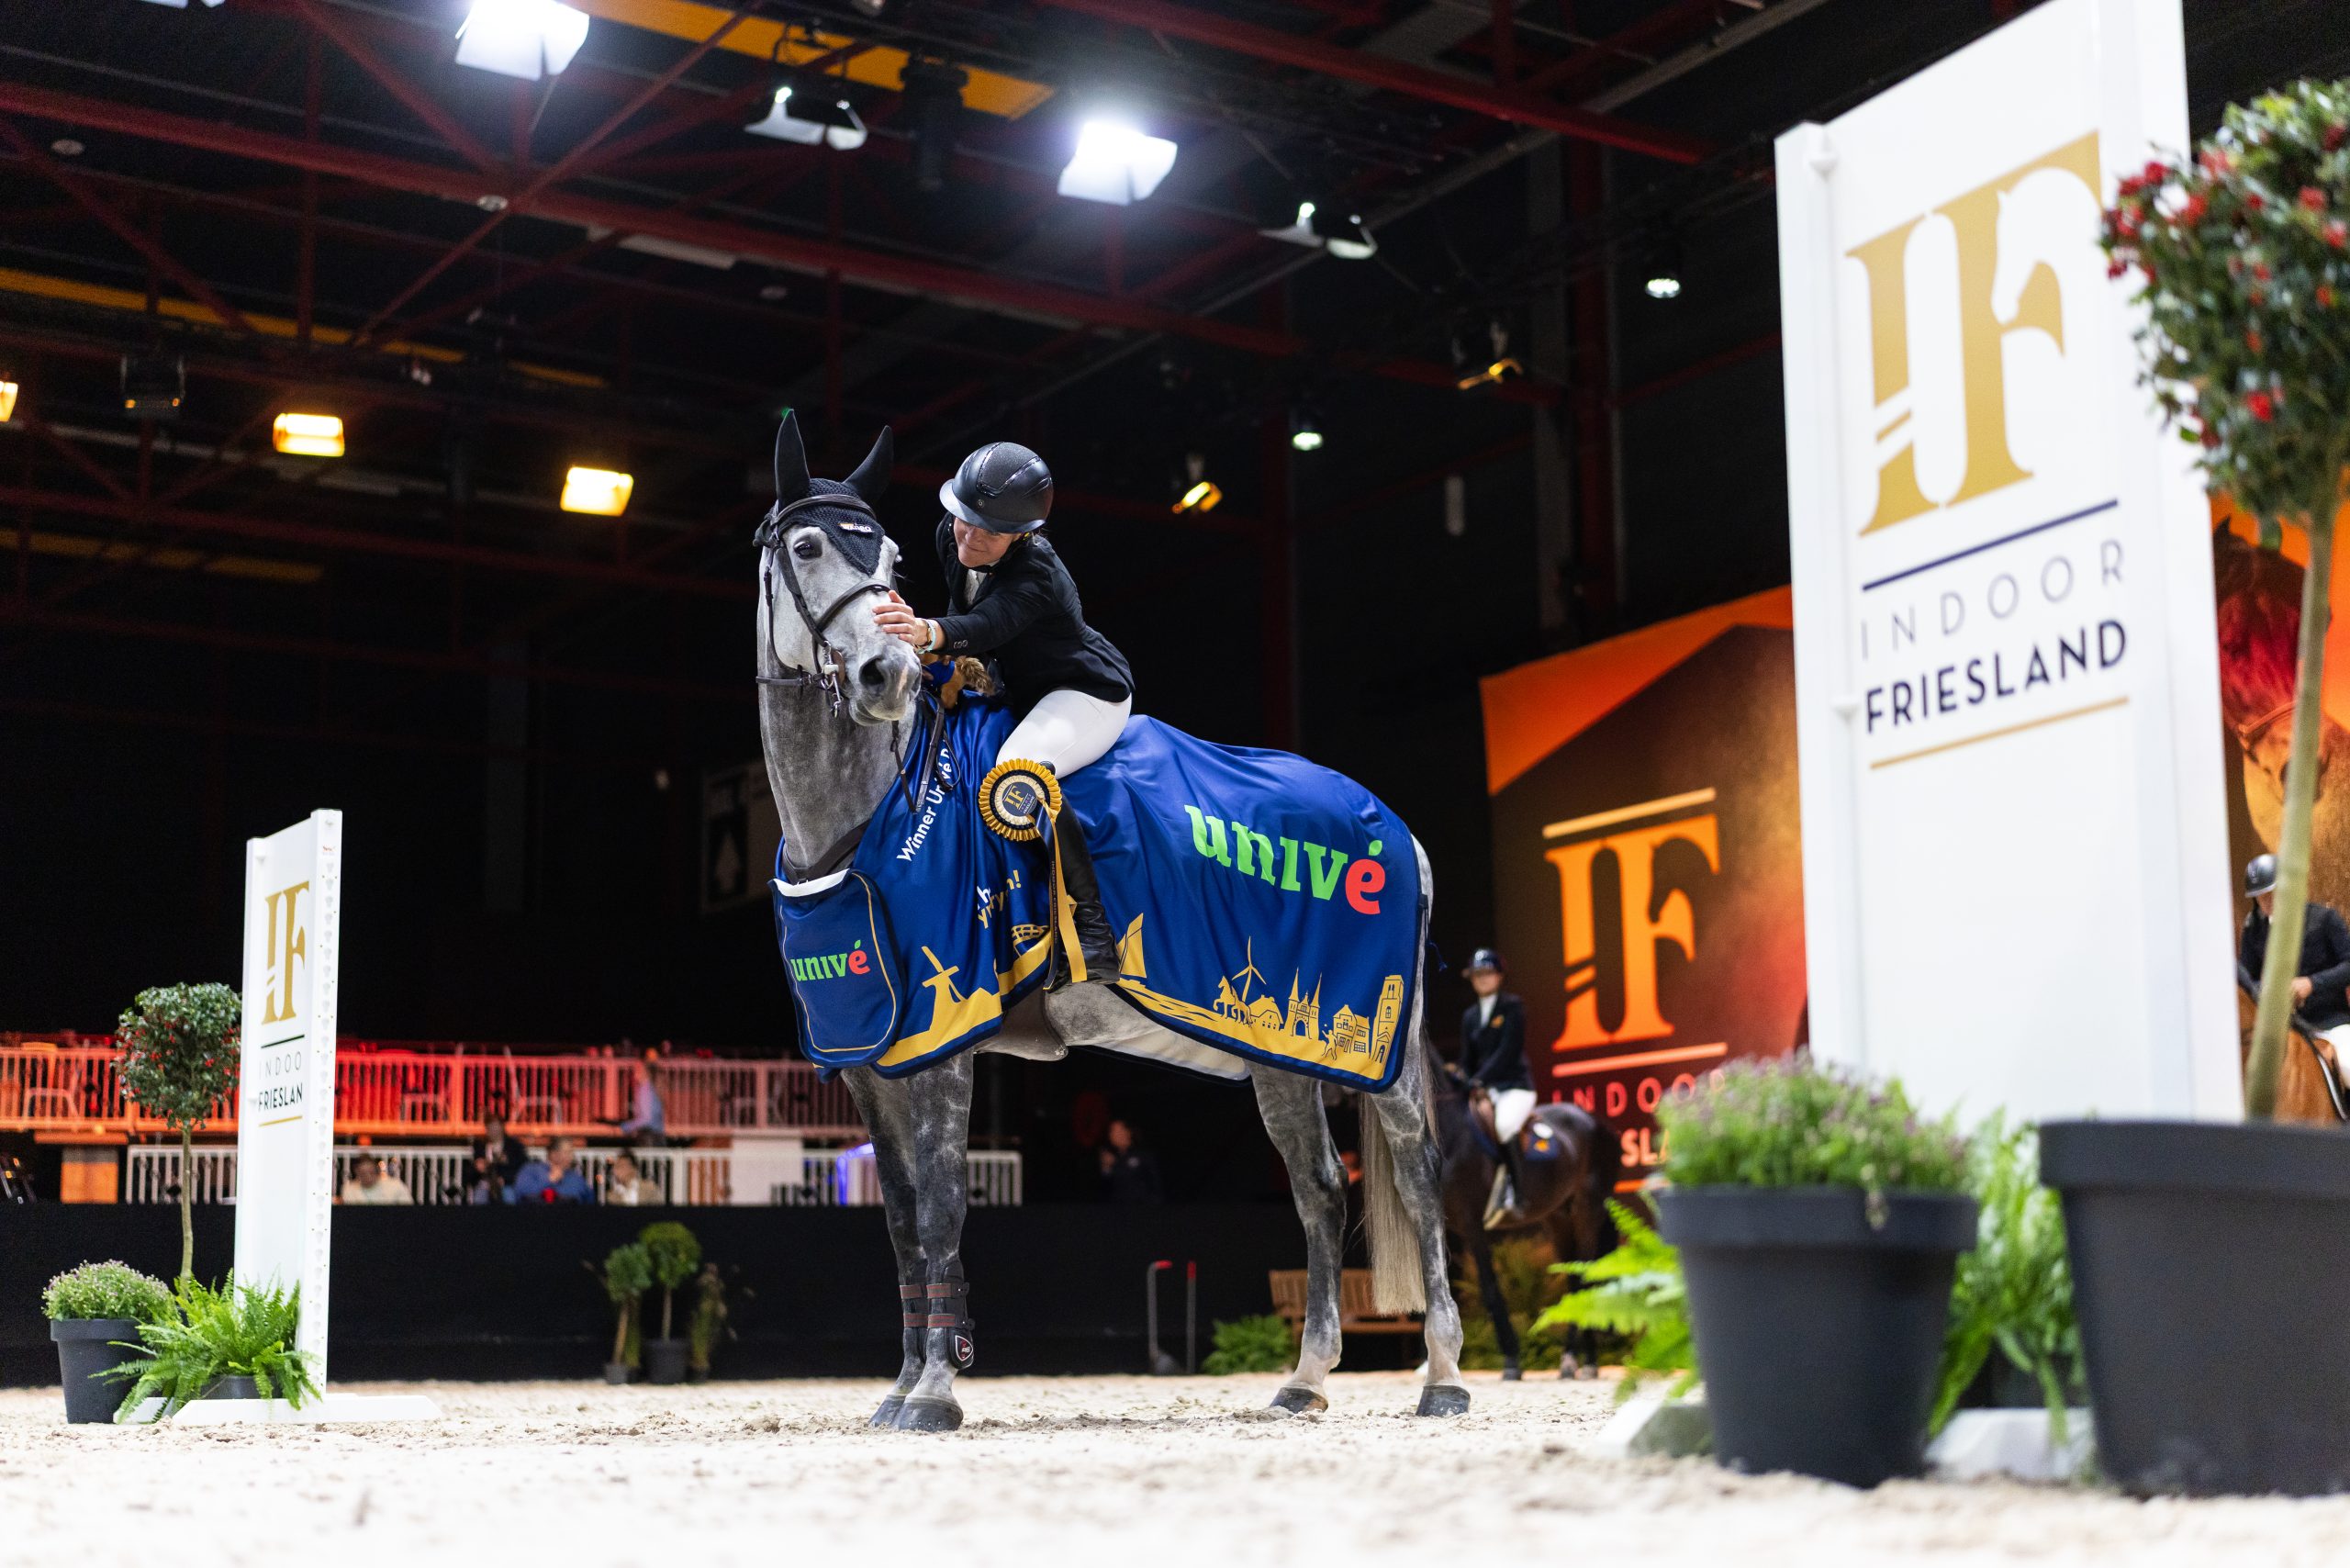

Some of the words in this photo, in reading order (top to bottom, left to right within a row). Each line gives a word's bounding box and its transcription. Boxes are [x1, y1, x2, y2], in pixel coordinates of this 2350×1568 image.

[1844, 129, 2104, 539] IF
[1860, 538, 2125, 661] INDOOR
[1865, 619, 2128, 734] FRIESLAND
[896, 805, 937, 862] Winner
[1183, 804, 1386, 915] univé
[789, 939, 870, 982] univé
[1544, 813, 1719, 1051] IF
[258, 1081, 303, 1113] FRIESLAN
[259, 1050, 302, 1081] INDOO
